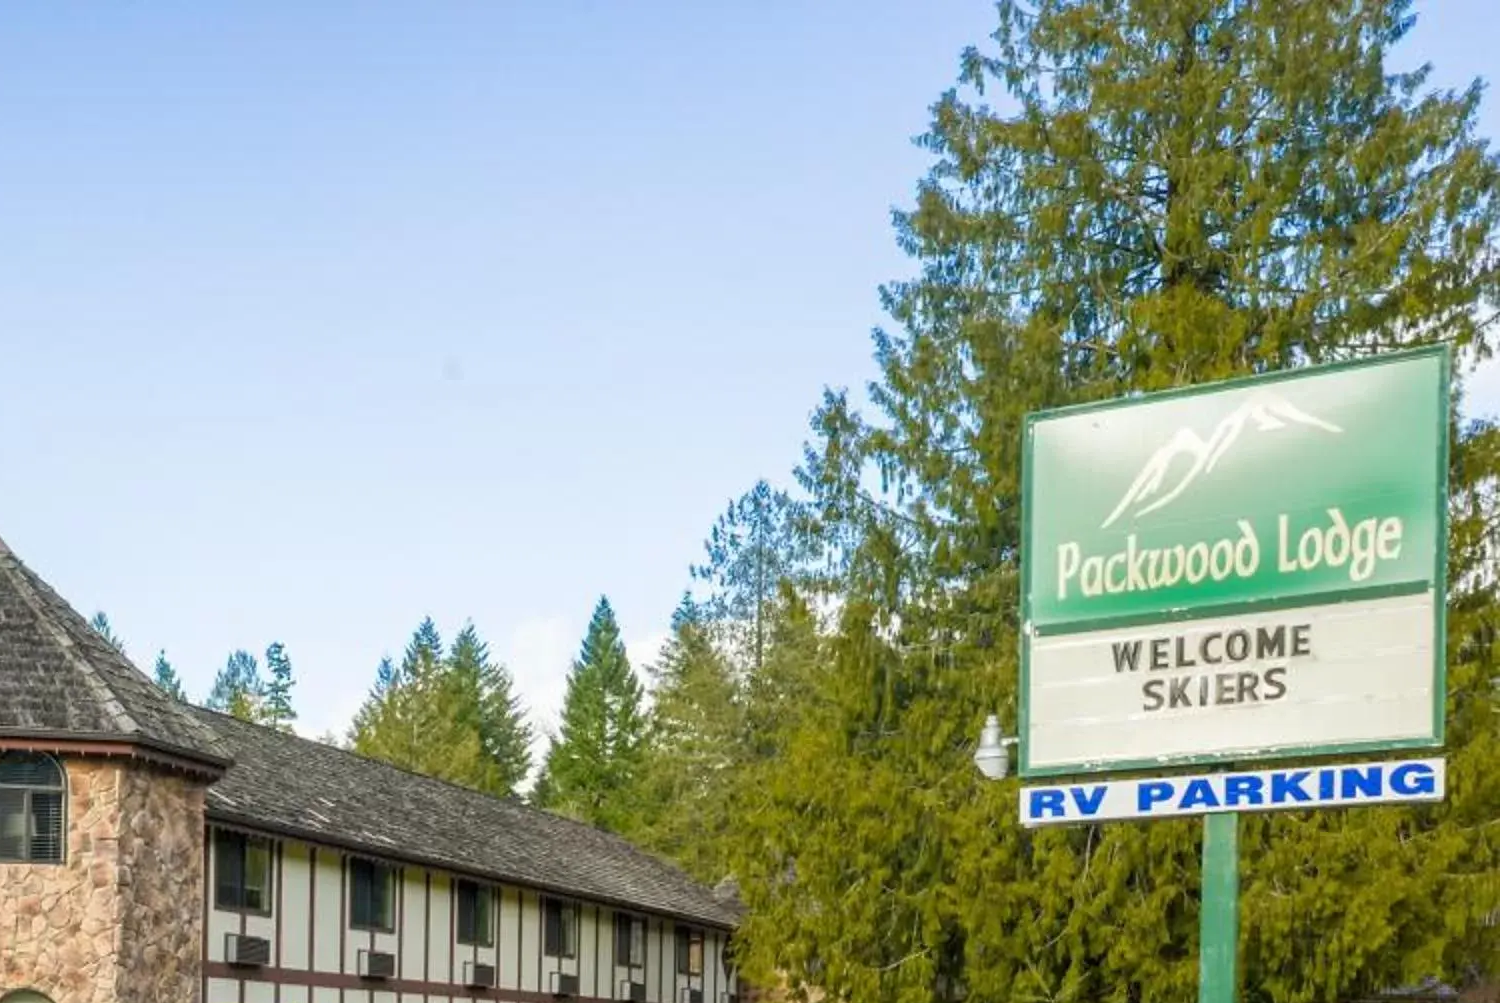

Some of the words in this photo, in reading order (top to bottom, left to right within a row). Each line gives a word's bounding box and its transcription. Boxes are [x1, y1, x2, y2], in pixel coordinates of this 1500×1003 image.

[1057, 520, 1259, 601] Packwood
[1279, 508, 1404, 581] Lodge
[1111, 624, 1312, 673] WELCOME
[1142, 668, 1287, 711] SKIERS
[1029, 786, 1109, 819] RV
[1137, 763, 1436, 811] PARKING
